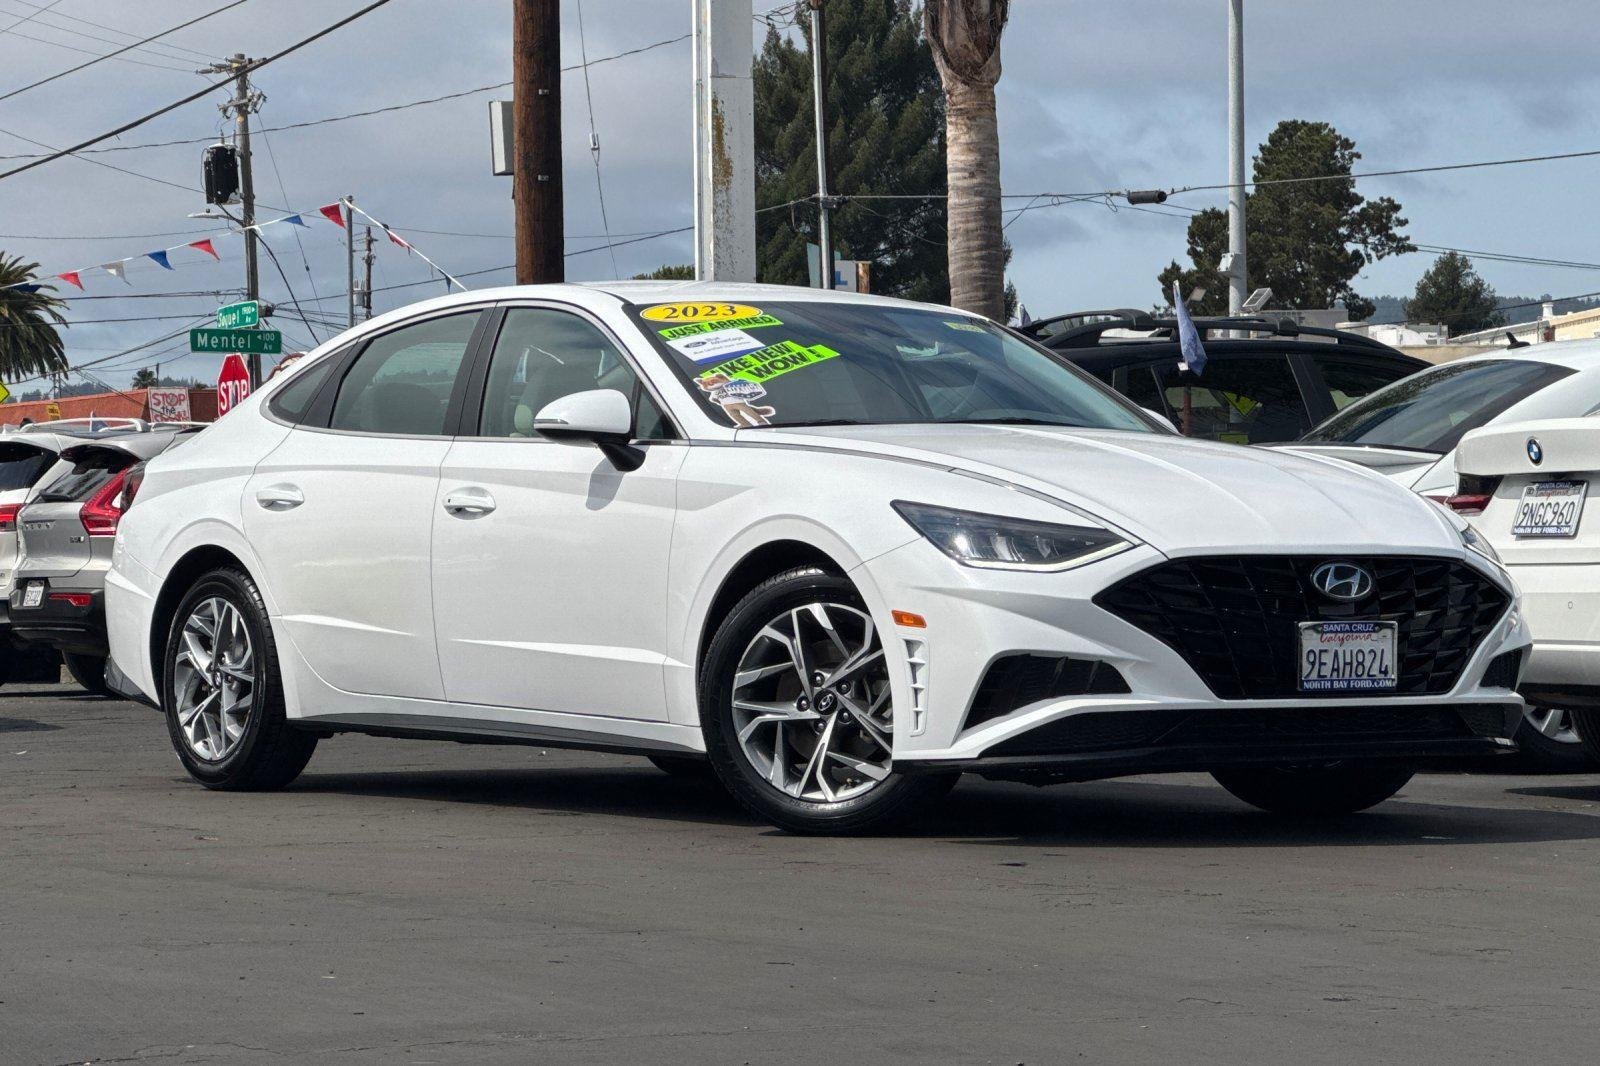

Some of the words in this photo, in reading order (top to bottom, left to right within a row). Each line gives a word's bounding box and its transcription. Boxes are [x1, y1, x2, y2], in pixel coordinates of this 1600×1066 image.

[663, 305, 737, 319] 2023
[667, 325, 706, 339] JUST
[708, 316, 774, 331] ARRIVED
[197, 332, 251, 349] Mentel
[749, 342, 793, 362] NEW
[745, 351, 809, 379] WOW
[152, 393, 186, 406] STOP
[220, 379, 249, 411] STOP
[160, 406, 176, 415] the
[1519, 501, 1575, 527] 9NGC960
[1323, 624, 1351, 632] SANTA
[1351, 624, 1374, 632] CRUZ
[1320, 633, 1372, 645] California
[1304, 648, 1389, 679] 9EAH824
[1303, 680, 1331, 689] NORTH
[1333, 680, 1348, 689] BAY
[1350, 680, 1392, 688] FORD.COM
